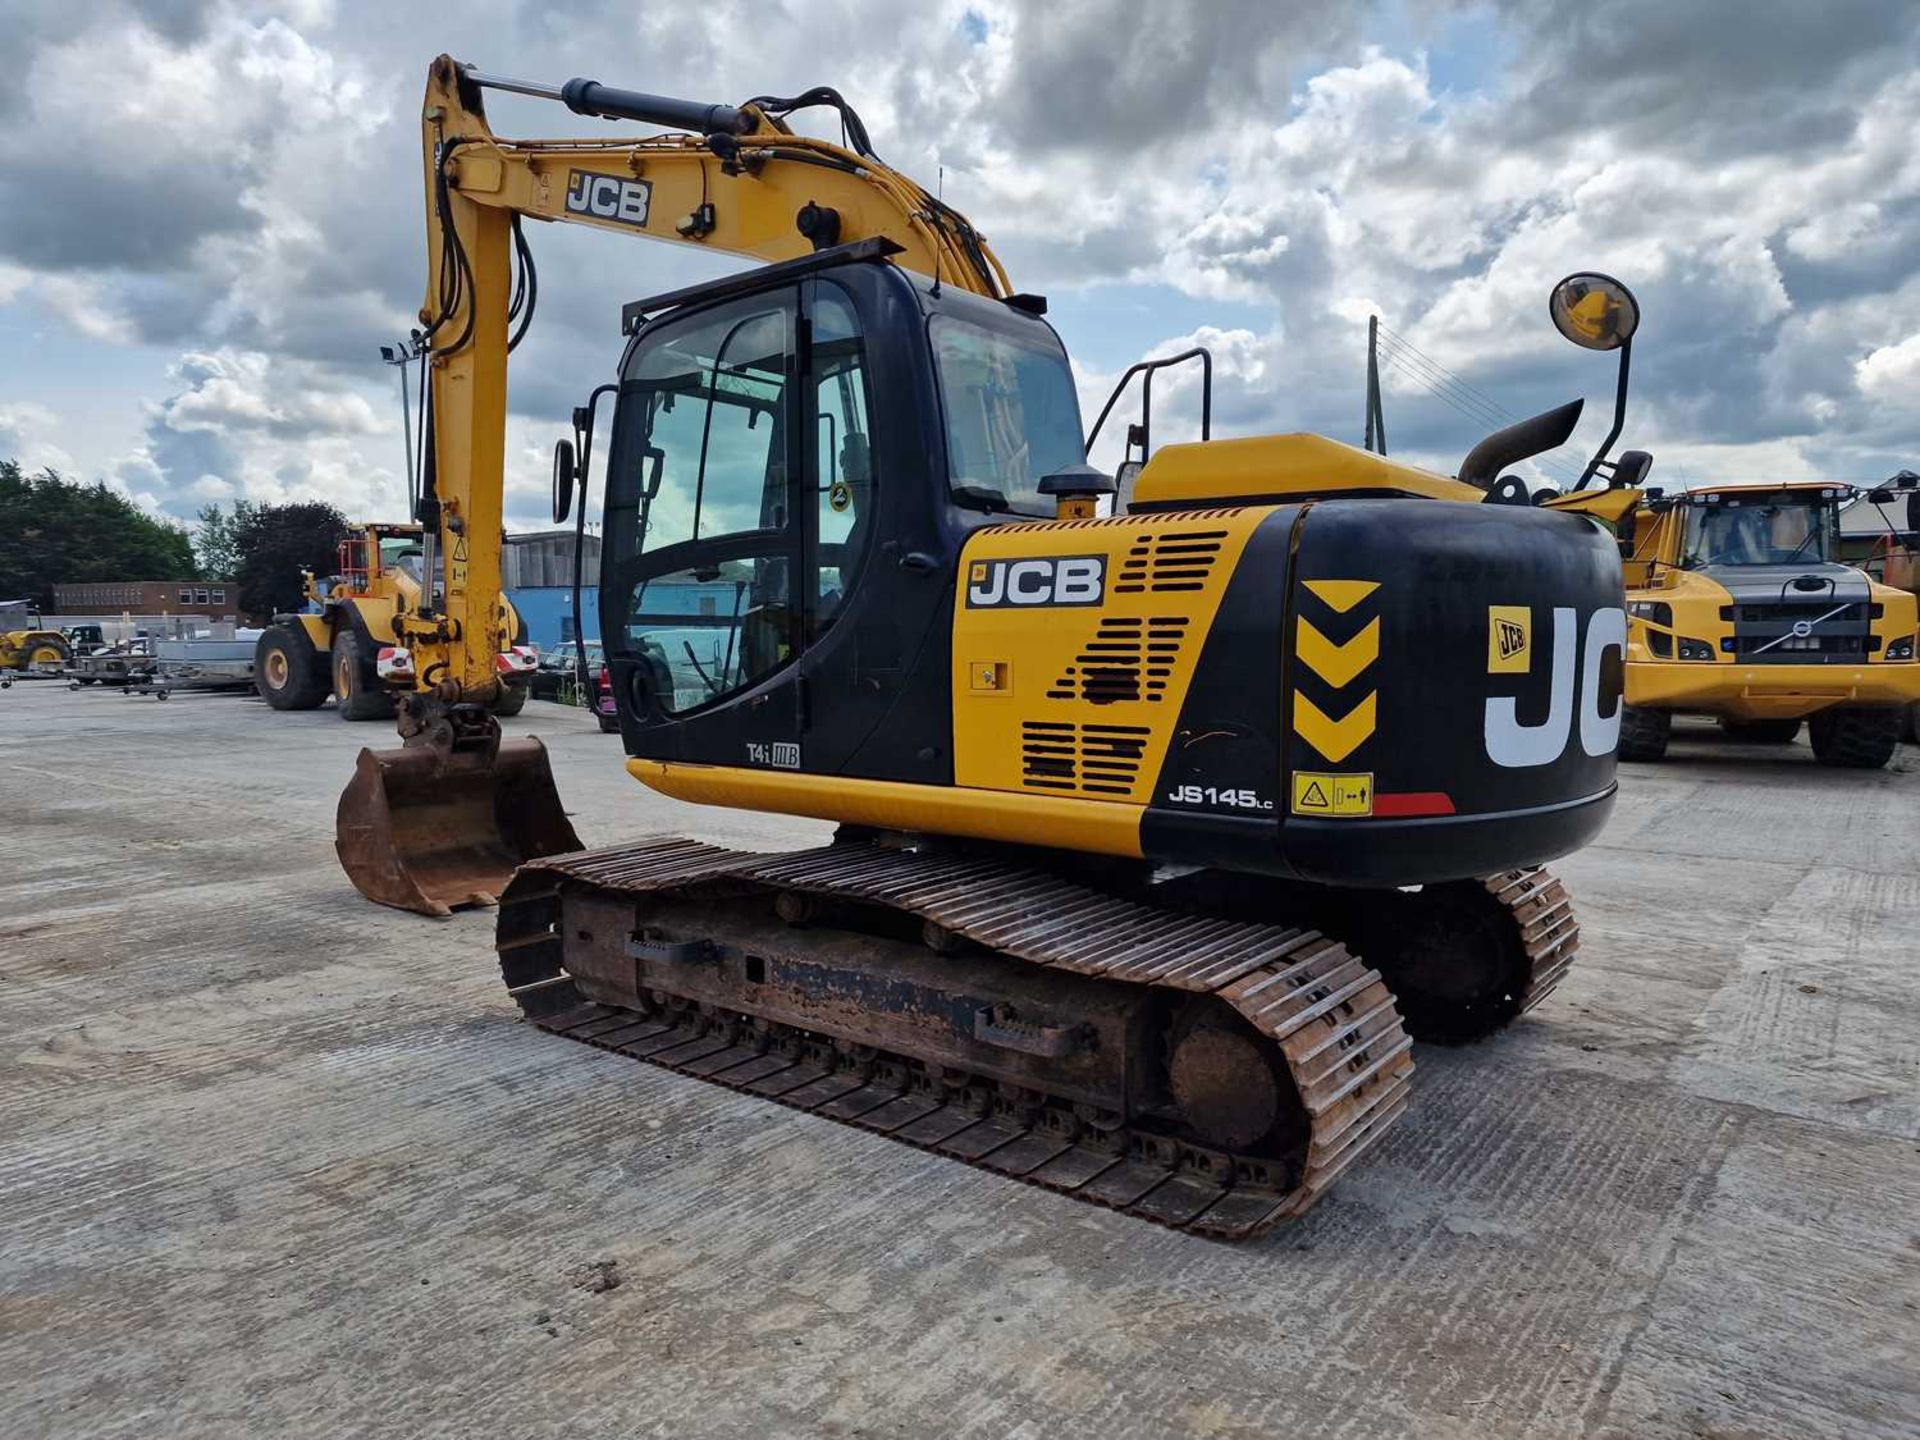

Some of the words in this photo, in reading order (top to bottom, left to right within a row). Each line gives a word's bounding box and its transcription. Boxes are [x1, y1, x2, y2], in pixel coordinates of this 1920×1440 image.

[568, 175, 649, 222] JCB
[970, 559, 1102, 605] JCB
[1501, 623, 1525, 655] JCB
[746, 743, 771, 764] T4i
